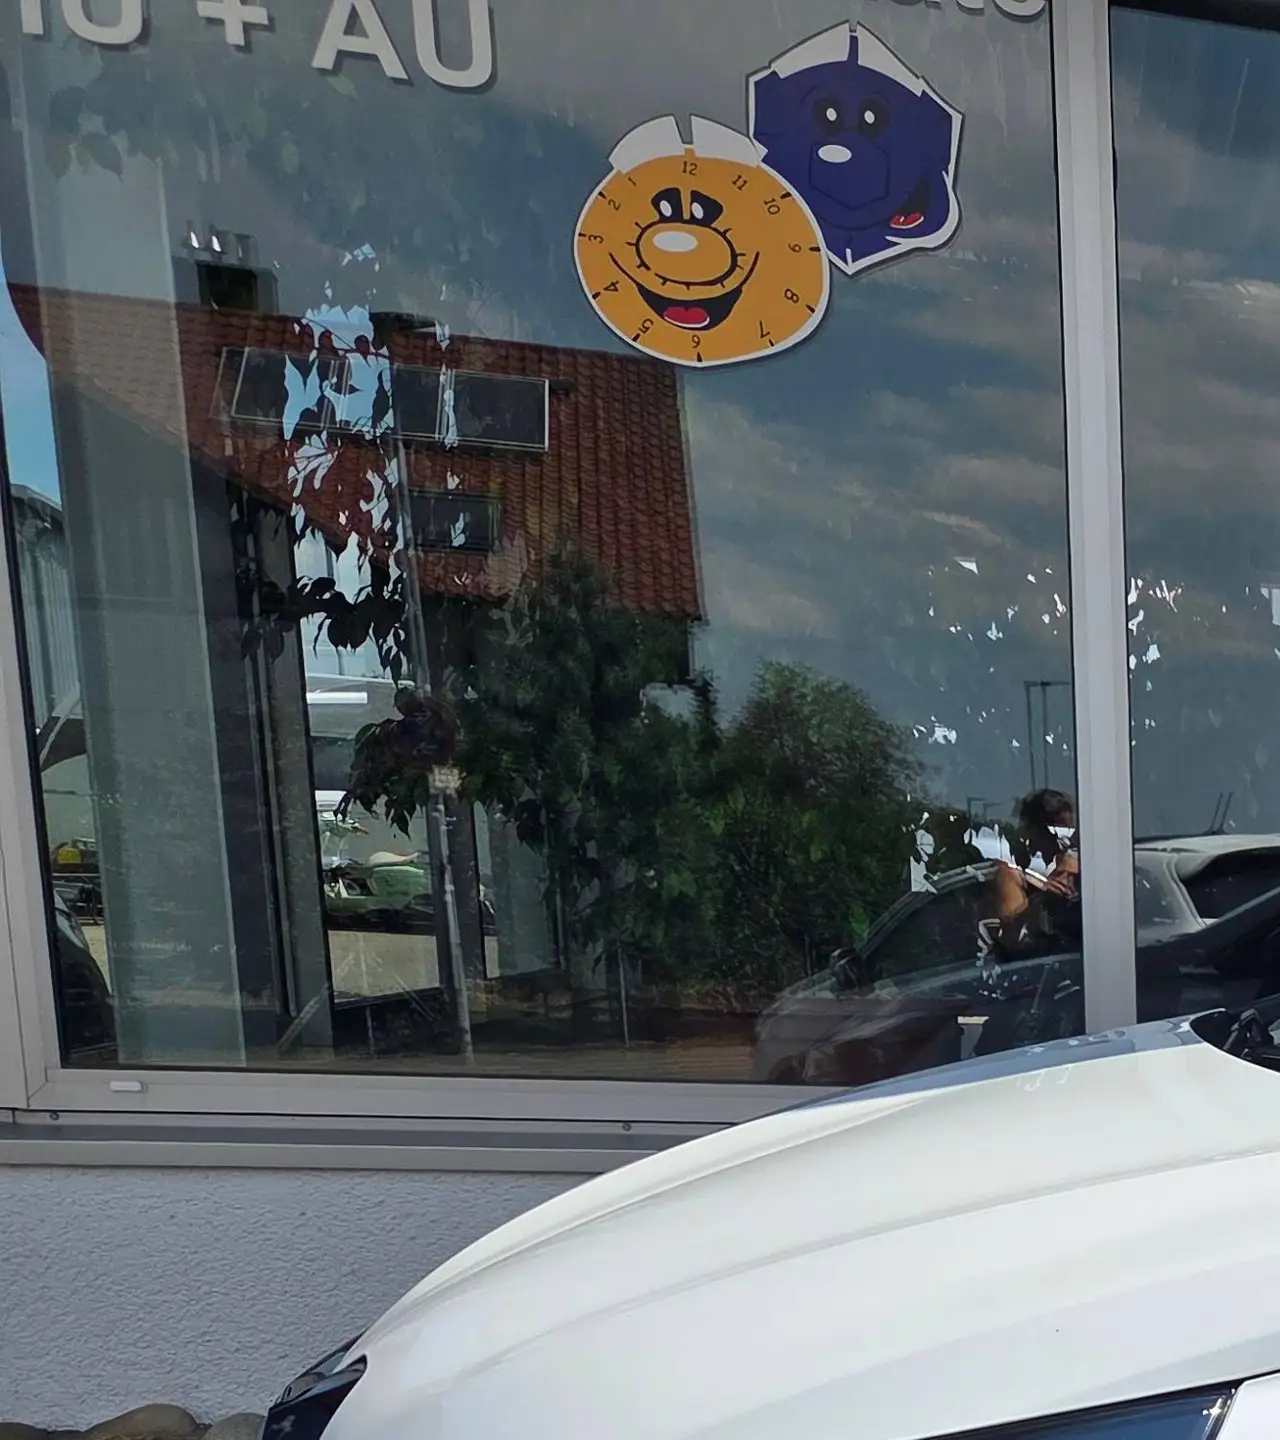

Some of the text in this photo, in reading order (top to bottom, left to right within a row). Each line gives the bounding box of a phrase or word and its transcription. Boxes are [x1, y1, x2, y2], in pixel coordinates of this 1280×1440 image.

[311, 0, 492, 88] AU
[681, 161, 698, 176] 12
[731, 175, 748, 190] 11
[608, 199, 621, 211] 2
[763, 197, 781, 215] 10
[588, 234, 604, 244] 3
[603, 280, 620, 293] 4
[784, 288, 800, 304] 8
[638, 318, 654, 334] 5
[691, 335, 700, 348] 6
